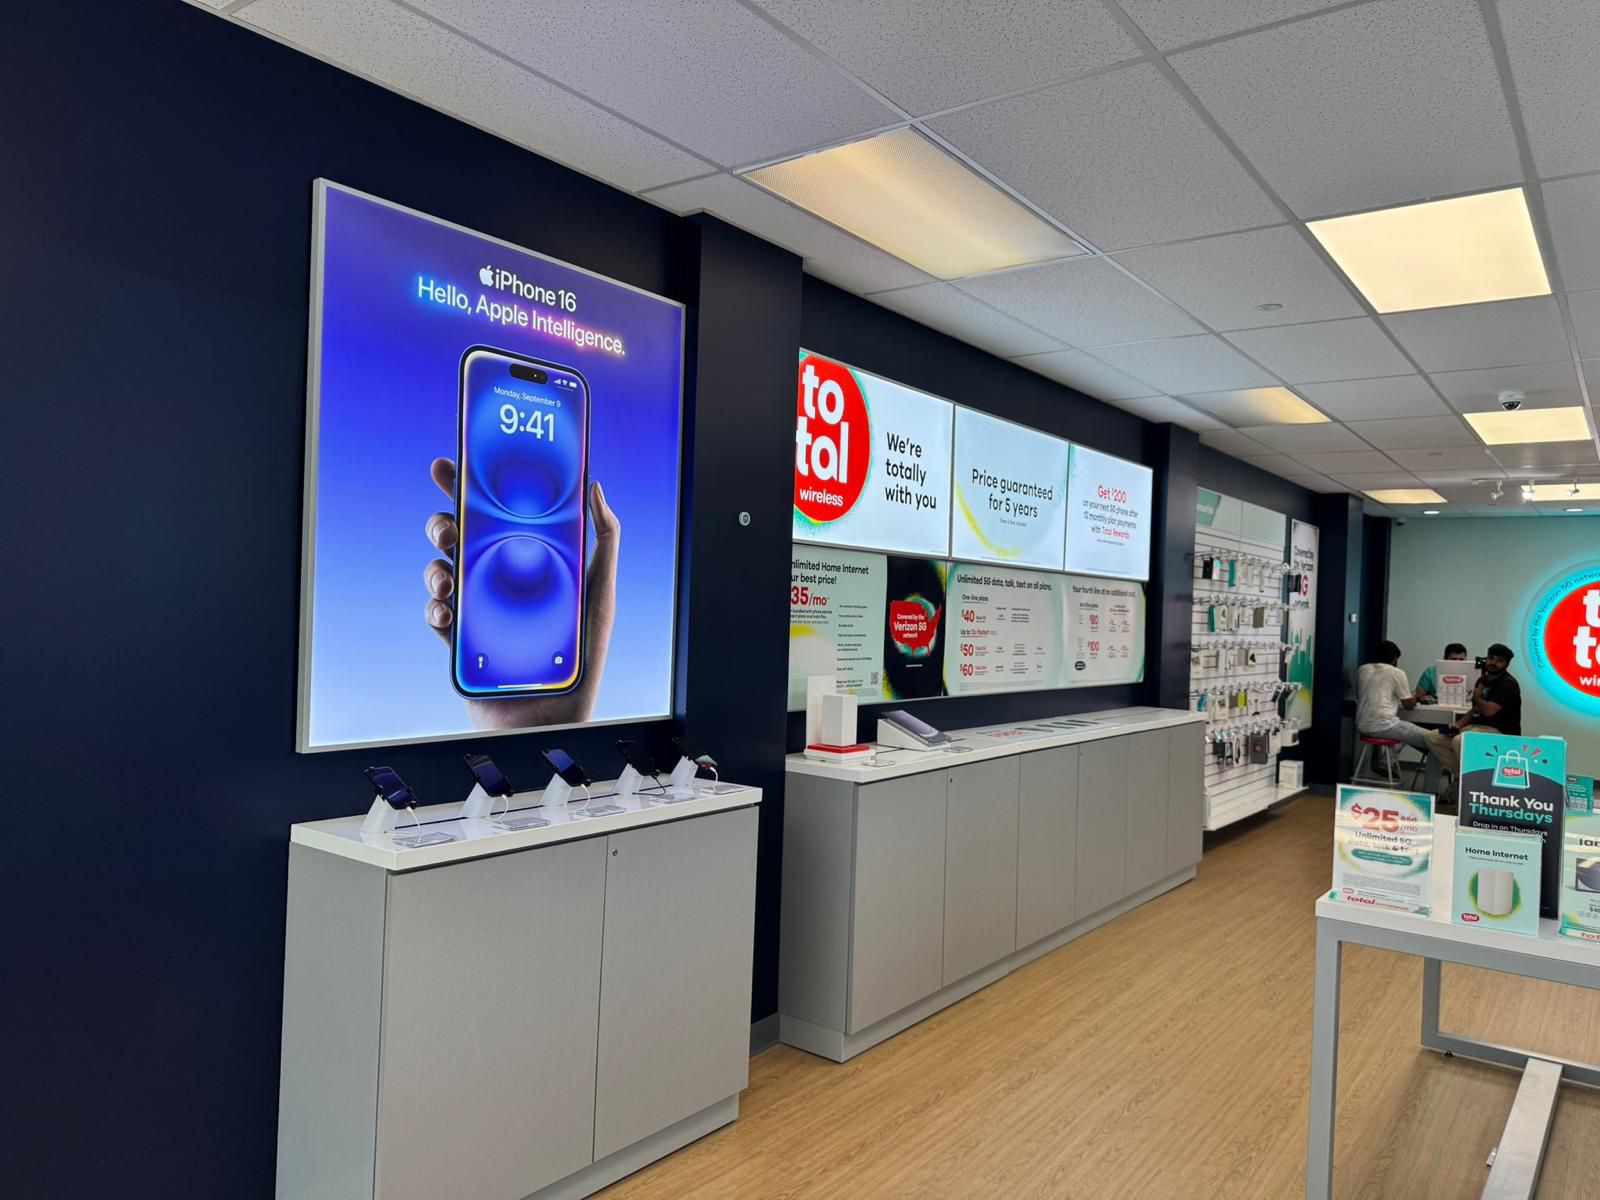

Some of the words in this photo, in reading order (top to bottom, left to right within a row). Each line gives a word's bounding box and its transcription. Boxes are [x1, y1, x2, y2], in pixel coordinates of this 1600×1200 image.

[495, 270, 556, 306] iPhone
[558, 289, 577, 312] 16
[418, 276, 471, 315] Hello,
[475, 295, 529, 327] Apple
[532, 310, 626, 355] Intelligence.
[493, 386, 521, 401] Monday,
[521, 391, 556, 408] September
[556, 399, 561, 408] 9
[802, 364, 845, 425] to
[499, 403, 555, 442] 9:41
[795, 416, 849, 484] tal
[886, 432, 923, 458] We're
[885, 458, 927, 487] totally
[972, 468, 998, 488] Price
[1000, 478, 1054, 501] guaranteed
[1097, 485, 1110, 500] Get
[799, 487, 843, 508] wireless
[885, 484, 911, 505] with
[915, 490, 937, 510] you
[989, 493, 1003, 511] for
[1005, 498, 1011, 512] 5
[1012, 502, 1038, 518] years
[791, 559, 820, 571] nlimited
[821, 562, 841, 573] Home
[842, 564, 869, 575] Internet
[800, 573, 817, 584] best
[817, 574, 837, 586] price!
[956, 574, 983, 585] Unlimited
[984, 577, 991, 586] 5G
[992, 578, 1004, 587] data,
[1005, 579, 1015, 588] talk,
[1016, 581, 1026, 589] text
[1573, 572, 1600, 586] netwo
[961, 609, 975, 623] $40
[1583, 589, 1600, 628] t
[893, 621, 918, 631] Verizon
[960, 643, 974, 657] $50
[960, 663, 974, 677] $60
[1503, 767, 1521, 776] total
[1469, 791, 1520, 809] Thank
[1523, 797, 1554, 812] You
[1350, 802, 1400, 833] $25
[1469, 802, 1553, 825] Thursdays
[1355, 831, 1398, 844] Unlimited
[1399, 838, 1412, 846] 5G
[1400, 824, 1418, 832] /mo
[1472, 820, 1491, 830] Drop
[1491, 822, 1499, 830] in
[1510, 825, 1548, 837] Thursdays
[1465, 846, 1491, 857] Home
[1492, 850, 1529, 861] Internet
[1463, 913, 1478, 921] total
